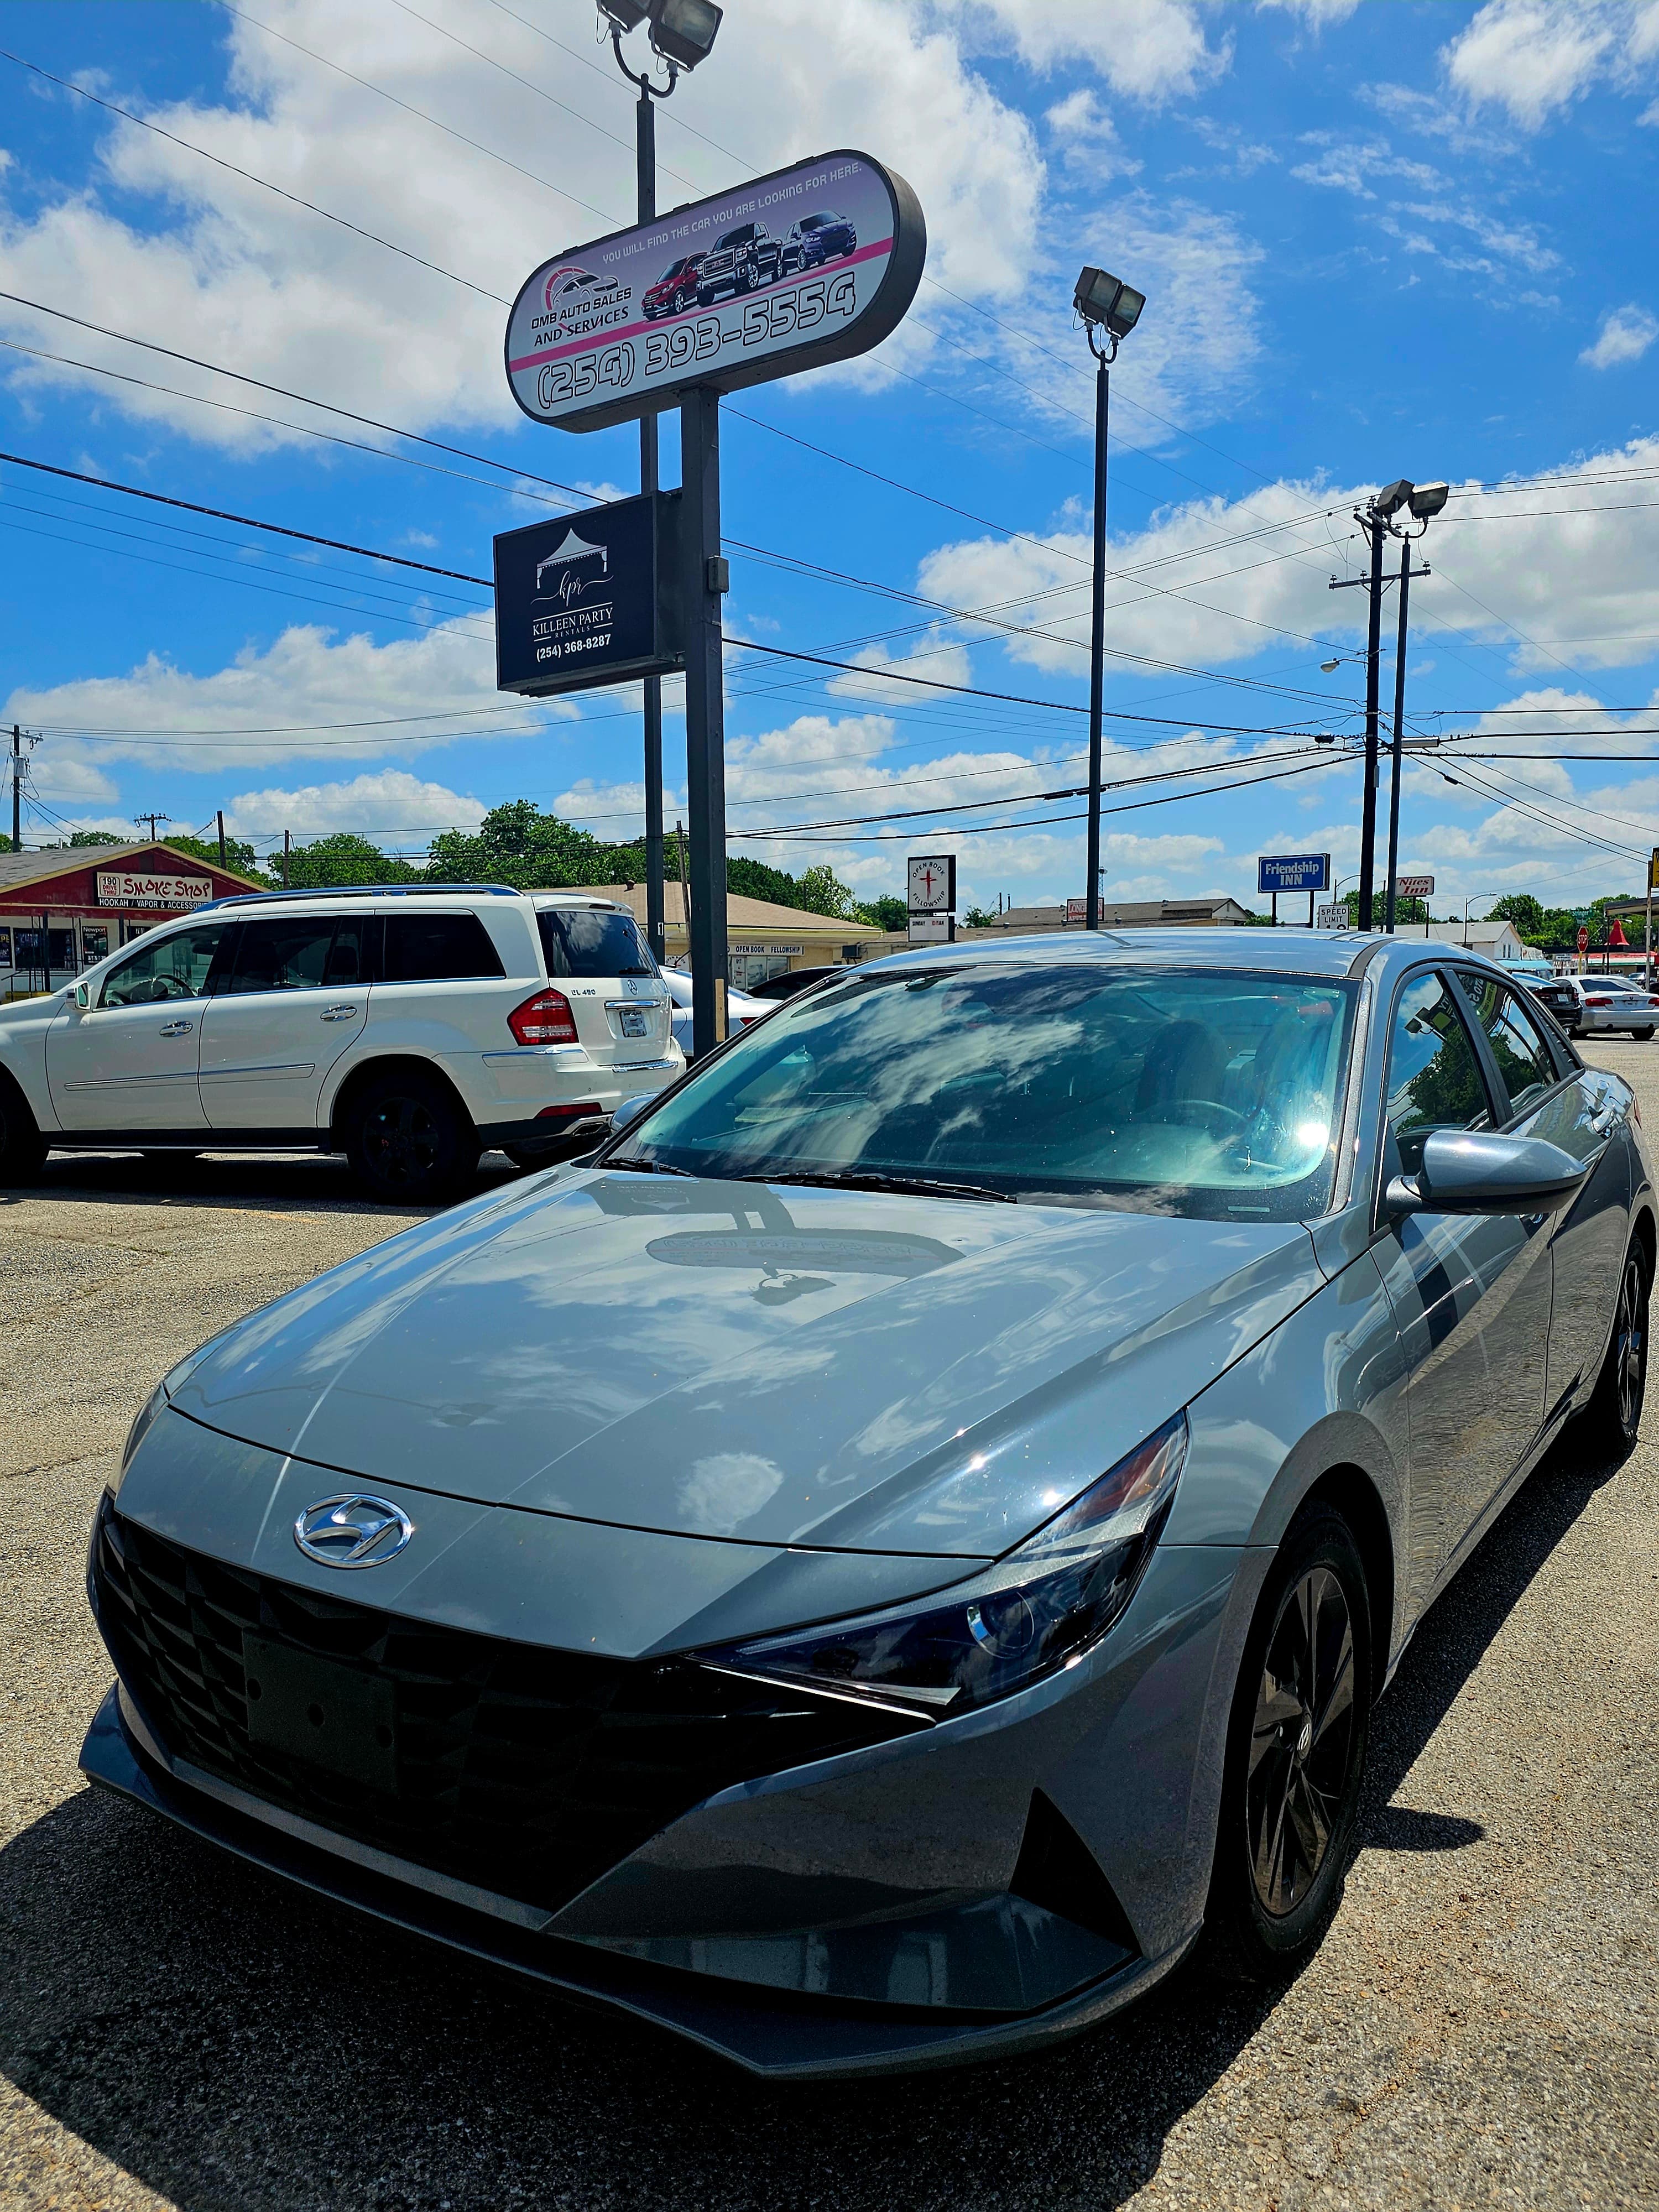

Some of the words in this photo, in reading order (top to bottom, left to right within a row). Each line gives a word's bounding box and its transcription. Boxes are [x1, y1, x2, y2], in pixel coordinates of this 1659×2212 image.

[603, 250, 620, 264] YOU
[623, 242, 645, 257] WILL
[648, 233, 669, 248] FIND
[671, 225, 689, 239] THE
[691, 218, 711, 232] CAR
[713, 209, 733, 225] YOU
[735, 201, 755, 217] ARE
[758, 184, 802, 208] LOOKING
[805, 174, 827, 191] FOR
[830, 162, 862, 182] HERE.
[559, 301, 591, 321] AUTO
[593, 287, 632, 310] SALES
[534, 328, 562, 347] AND
[567, 306, 629, 337] SERVICES
[538, 342, 635, 409] (254)
[645, 271, 856, 376] 393-5554
[533, 615, 576, 636] KILLEEN
[579, 607, 613, 625] PARTY
[555, 625, 591, 639] RENTALS
[536, 644, 561, 662] (254)
[564, 634, 611, 654] 368-8287
[912, 862, 927, 878] OPEN
[929, 862, 945, 876] BOOK
[1265, 860, 1319, 875] Friendship
[102, 877, 117, 885] 190
[123, 878, 172, 899] SMOKE
[1280, 874, 1302, 885] INN
[99, 898, 128, 907] HOOKAH
[137, 900, 158, 909] VAPOR
[168, 901, 208, 910] ACCESSOR
[912, 890, 946, 907] FELLOWSHIP
